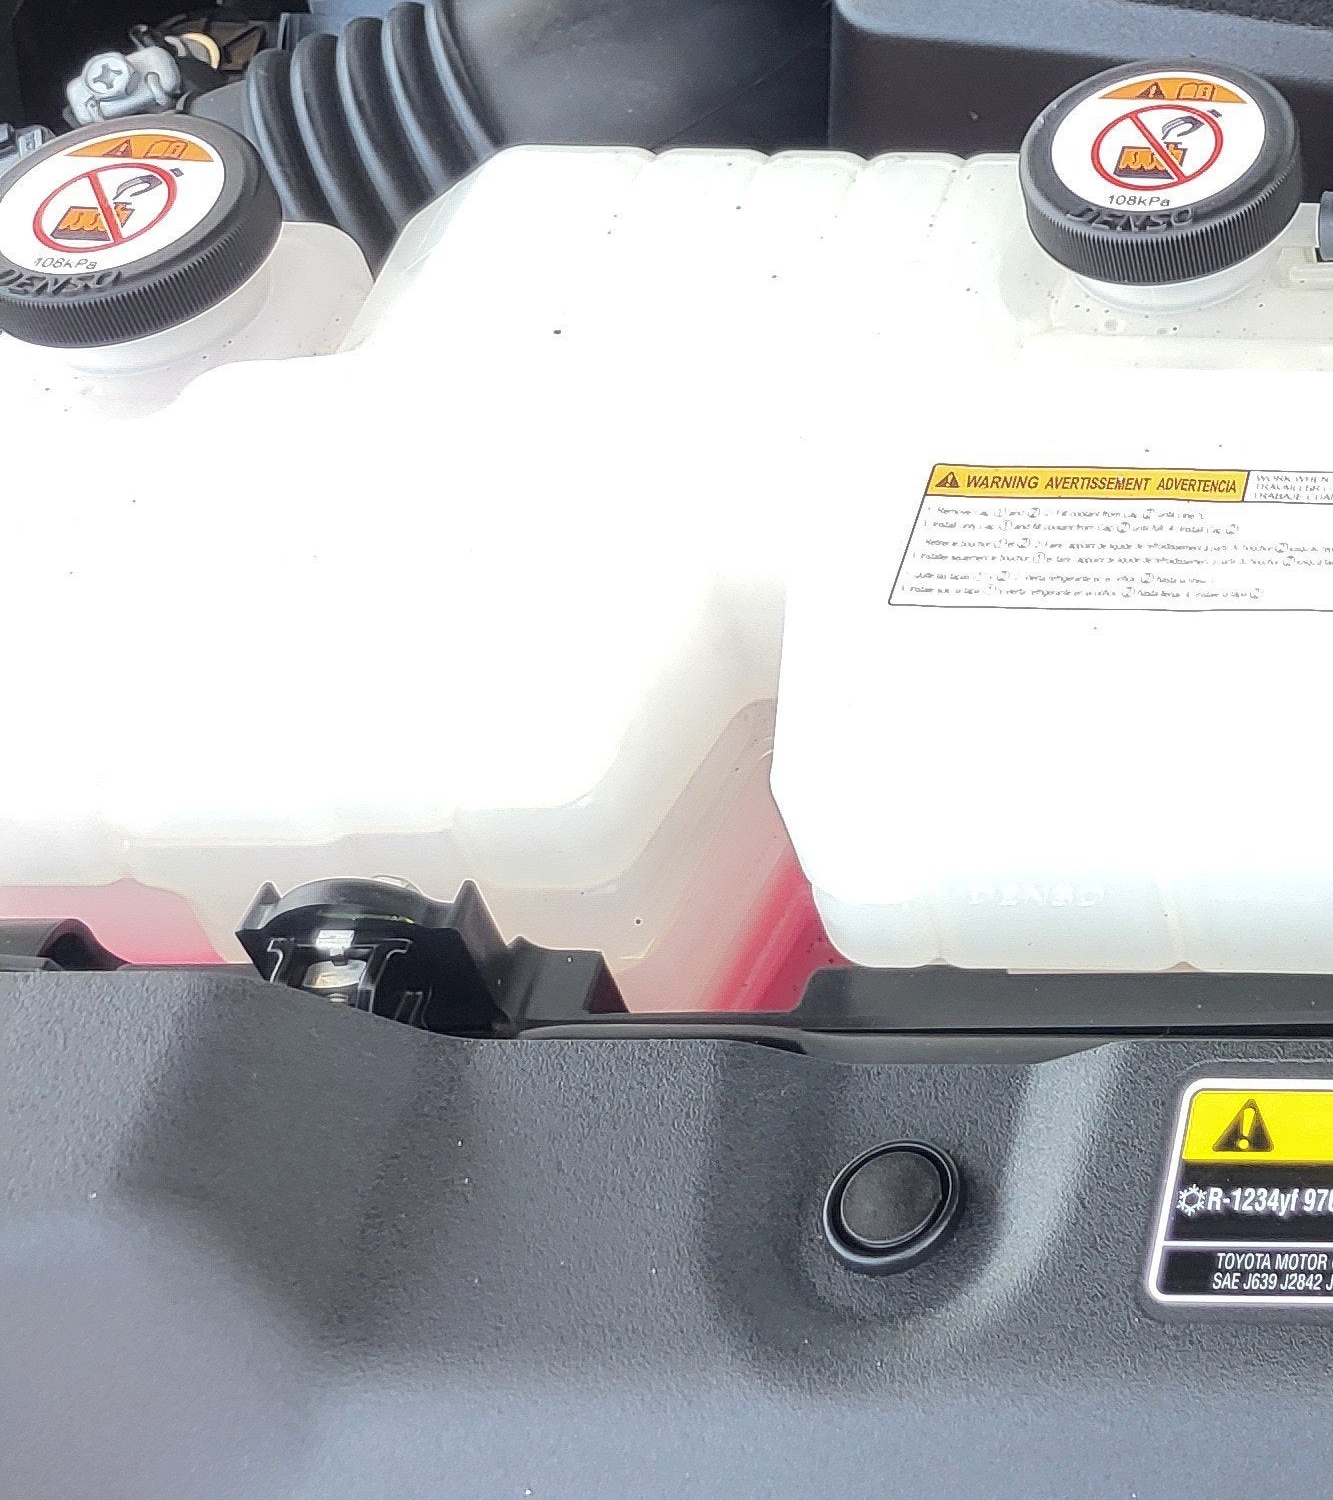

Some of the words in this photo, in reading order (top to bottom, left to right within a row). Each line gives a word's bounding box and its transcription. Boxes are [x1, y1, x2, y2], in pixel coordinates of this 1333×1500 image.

[1108, 194, 1171, 207] 108kPa
[966, 474, 1039, 490] WARNING
[1045, 476, 1151, 491] AVERTISSEMENT
[1156, 477, 1237, 493] ADVERTENCIA
[1206, 1187, 1299, 1216] R-1234yf
[1216, 1253, 1270, 1270] TOYOTA
[1275, 1253, 1327, 1270] MOTOR
[1212, 1272, 1241, 1289] SAE
[1243, 1273, 1277, 1290] J639
[1280, 1273, 1323, 1291] J2842
